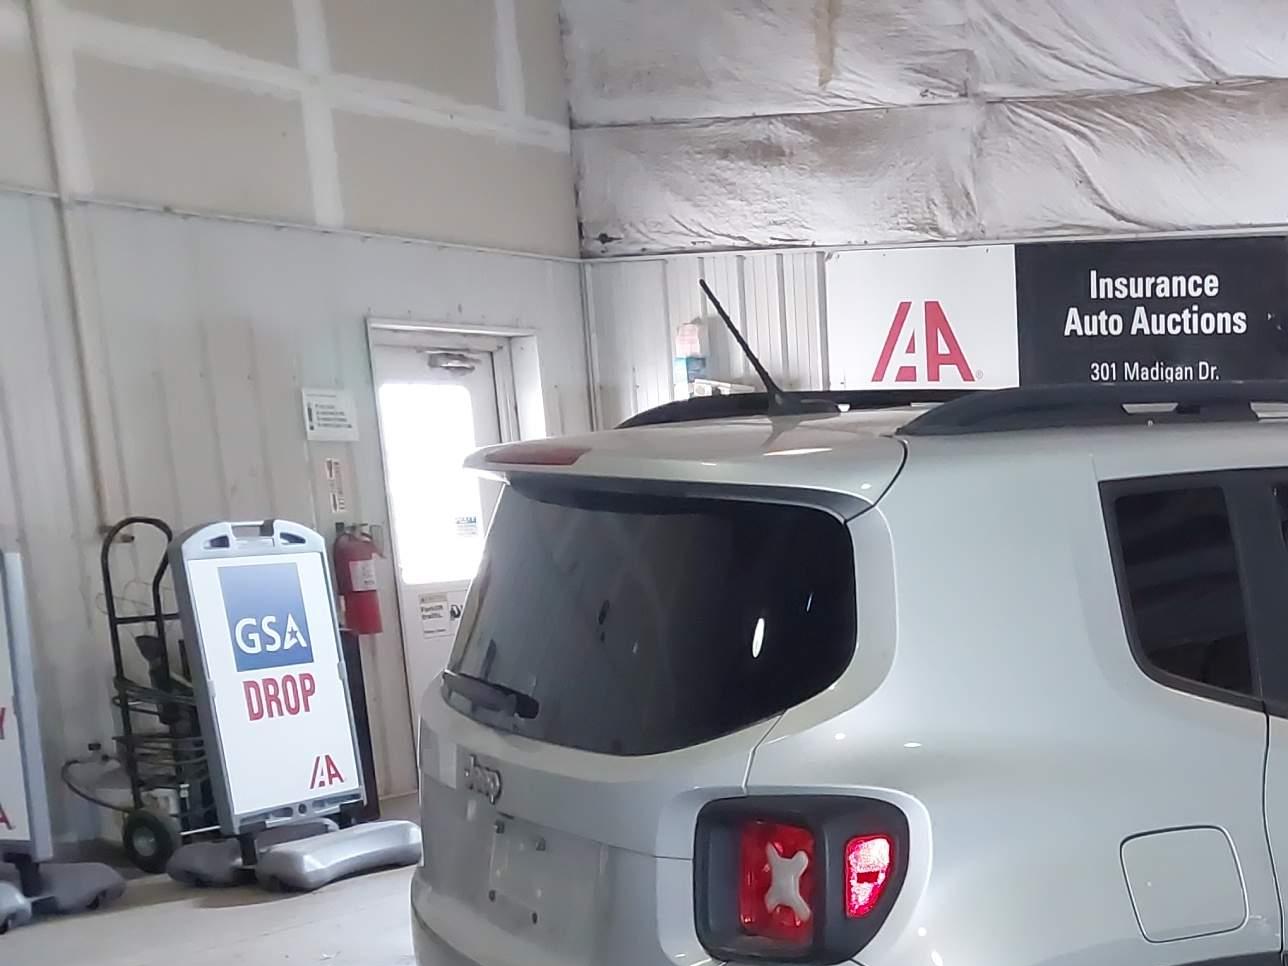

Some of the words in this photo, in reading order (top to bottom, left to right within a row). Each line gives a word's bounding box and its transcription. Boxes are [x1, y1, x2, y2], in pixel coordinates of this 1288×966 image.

[1090, 269, 1220, 299] Insurance
[1063, 306, 1124, 336] Auto
[1130, 304, 1248, 336] Auctions
[1090, 361, 1117, 381] 301
[1123, 361, 1194, 383] Madigan
[1198, 360, 1220, 381] Dr.
[235, 612, 308, 654] GSA
[242, 672, 316, 722] DROP
